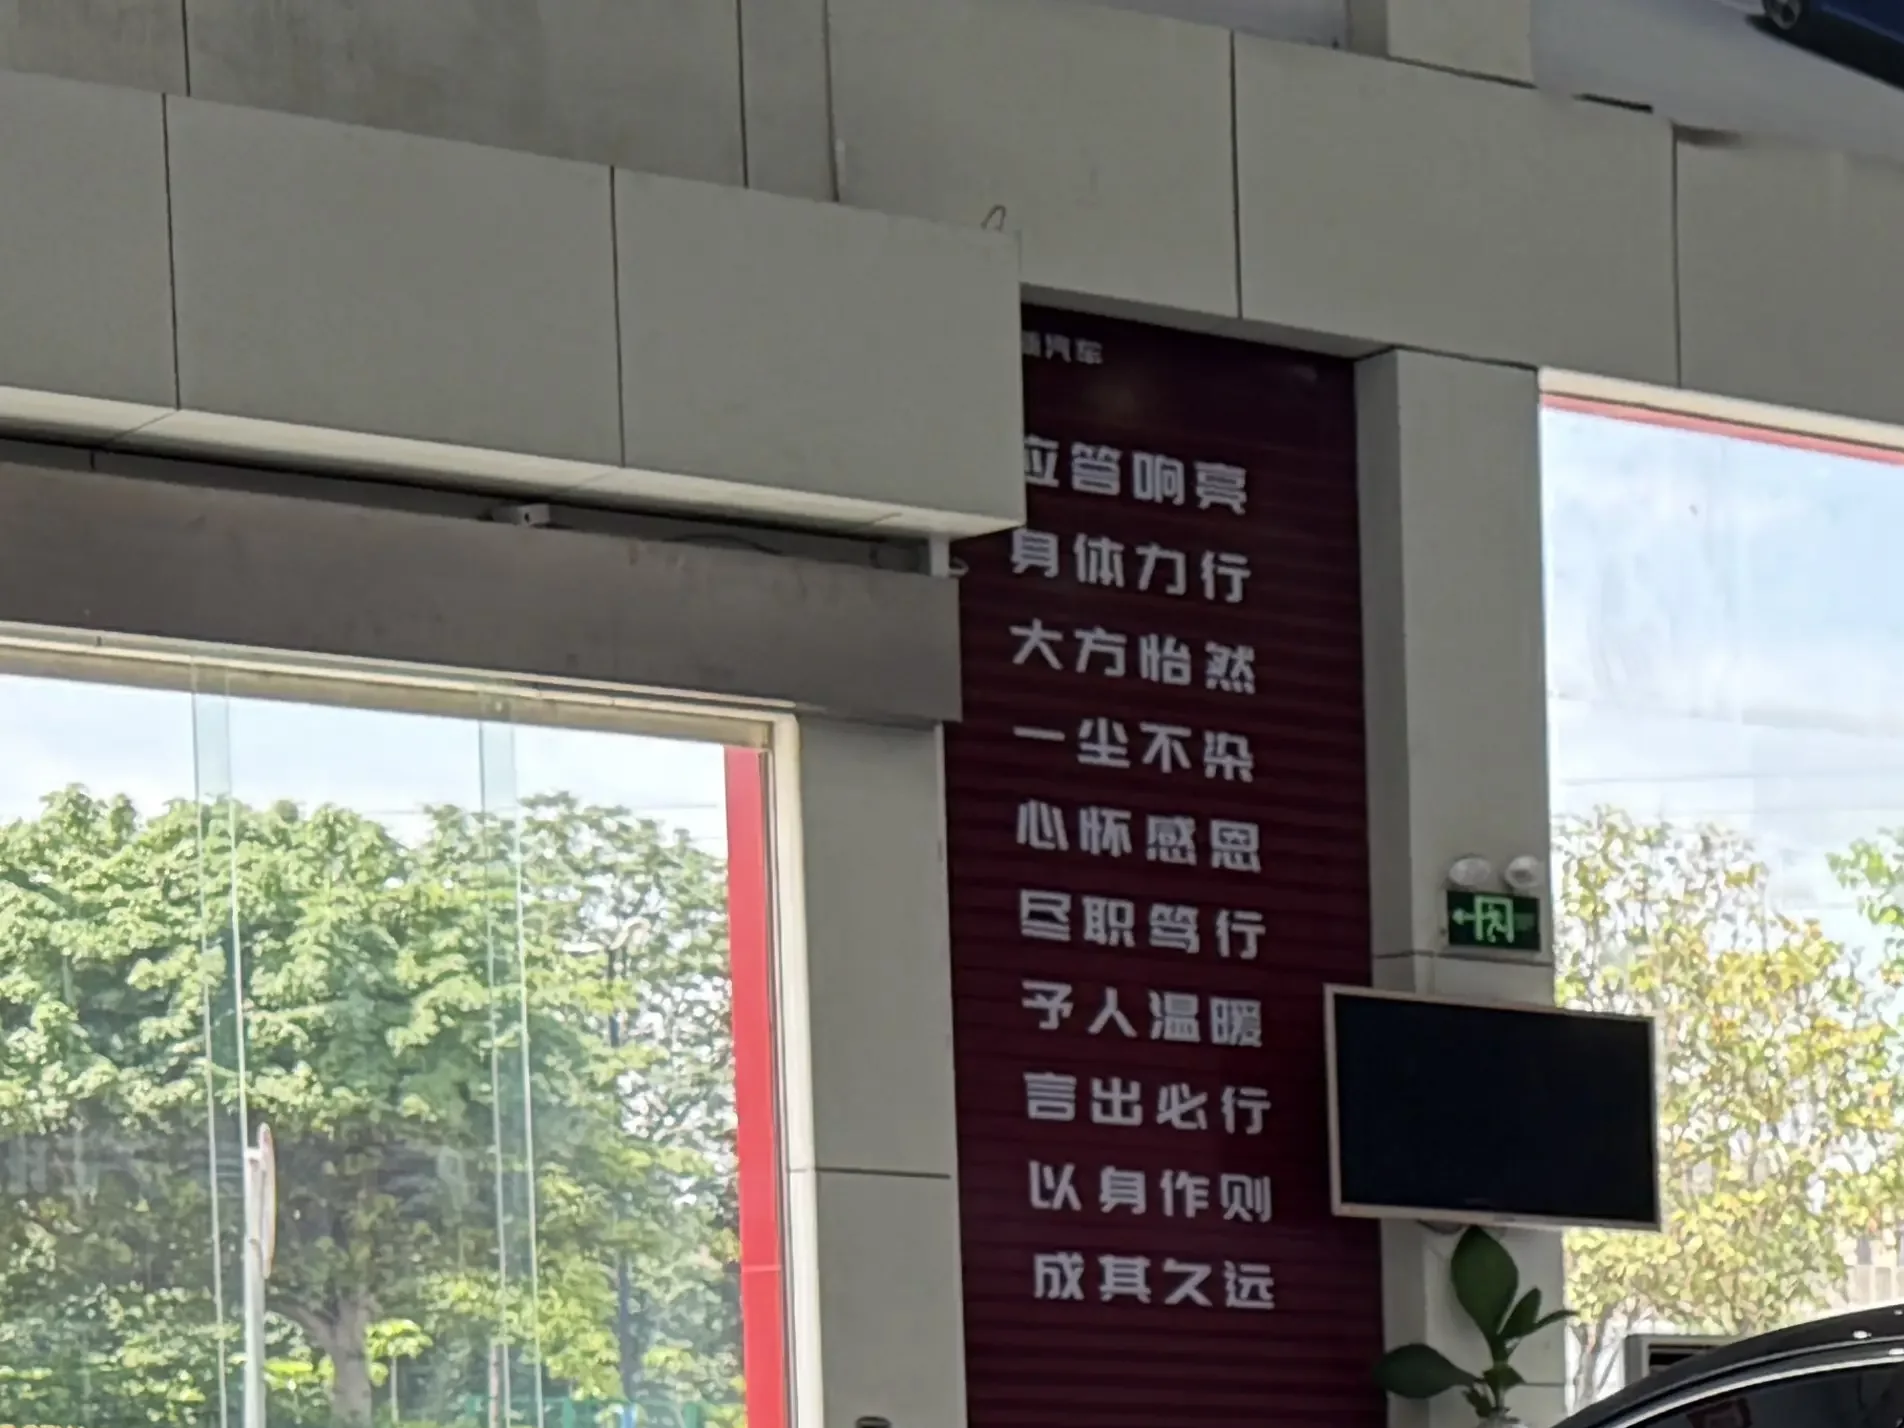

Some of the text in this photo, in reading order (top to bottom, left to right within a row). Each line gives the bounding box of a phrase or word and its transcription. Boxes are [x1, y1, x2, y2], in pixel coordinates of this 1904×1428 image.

[1024, 434, 1248, 515] 应答响亮
[1010, 527, 1251, 603] 身体力行
[1009, 618, 1255, 694] 大方怡然
[1012, 717, 1254, 782] 一尘不染
[1016, 799, 1262, 873] 心怀感恩
[1020, 889, 1266, 959] 尽职笃行
[1021, 978, 1262, 1048] 予人温暖
[1022, 1071, 1271, 1134] 言出必行
[1028, 1160, 1272, 1223] 以身作则
[1033, 1252, 1275, 1310] 成其久远
